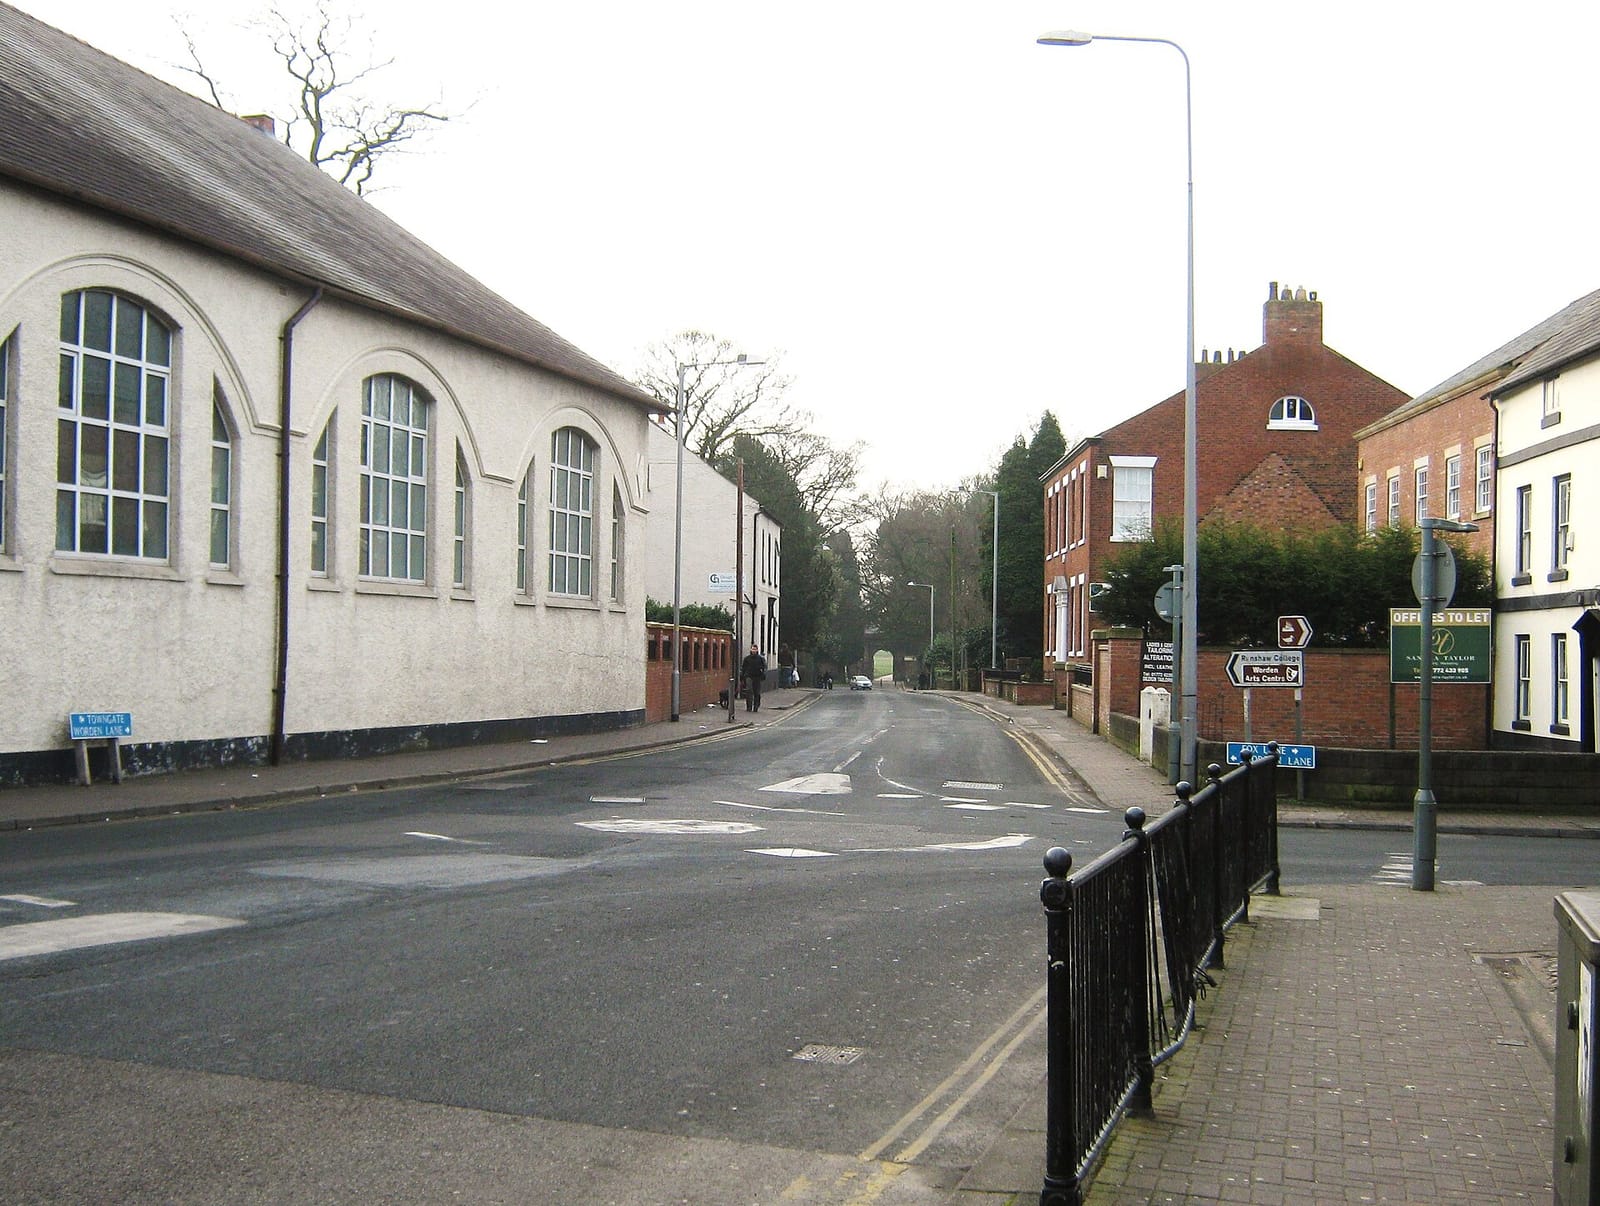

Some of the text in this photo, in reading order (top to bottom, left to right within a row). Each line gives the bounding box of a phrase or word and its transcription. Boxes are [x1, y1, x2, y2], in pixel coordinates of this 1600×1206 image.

[1393, 612, 1489, 623] OFFIES TO LET
[1273, 654, 1300, 664] College
[1252, 666, 1279, 674] Worden
[87, 714, 125, 724] TOWNGATE
[73, 726, 123, 737] WORDEN LANE
[1263, 746, 1287, 755] LNE
[1288, 757, 1312, 767] LANE
